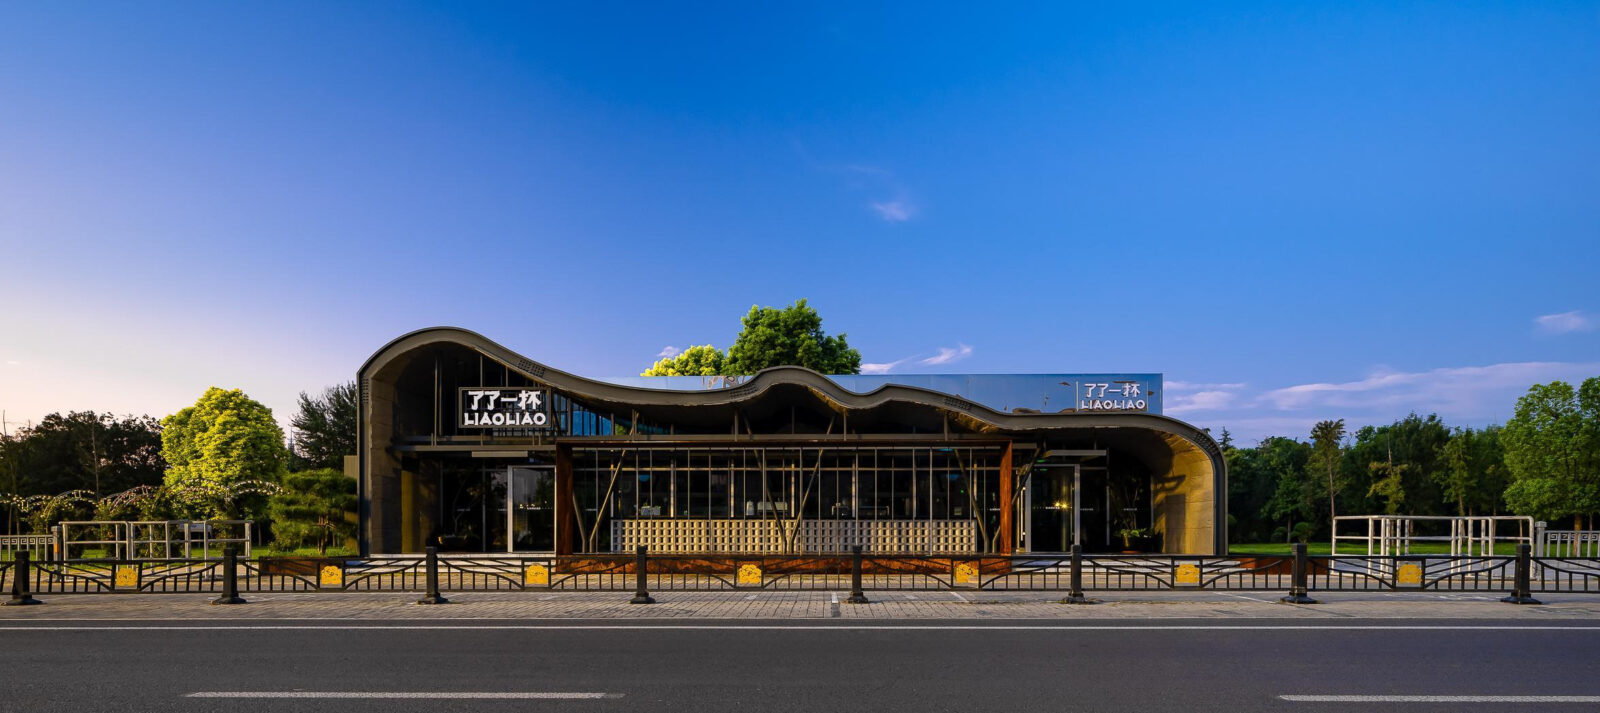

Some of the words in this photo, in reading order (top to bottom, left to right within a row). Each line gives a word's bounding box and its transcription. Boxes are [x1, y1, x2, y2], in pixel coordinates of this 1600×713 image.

[1084, 383, 1140, 398] 了了一杯
[468, 390, 541, 410] 了了一杯
[1081, 399, 1146, 410] LIAOLIAO
[464, 412, 546, 425] LIAOLIAO
